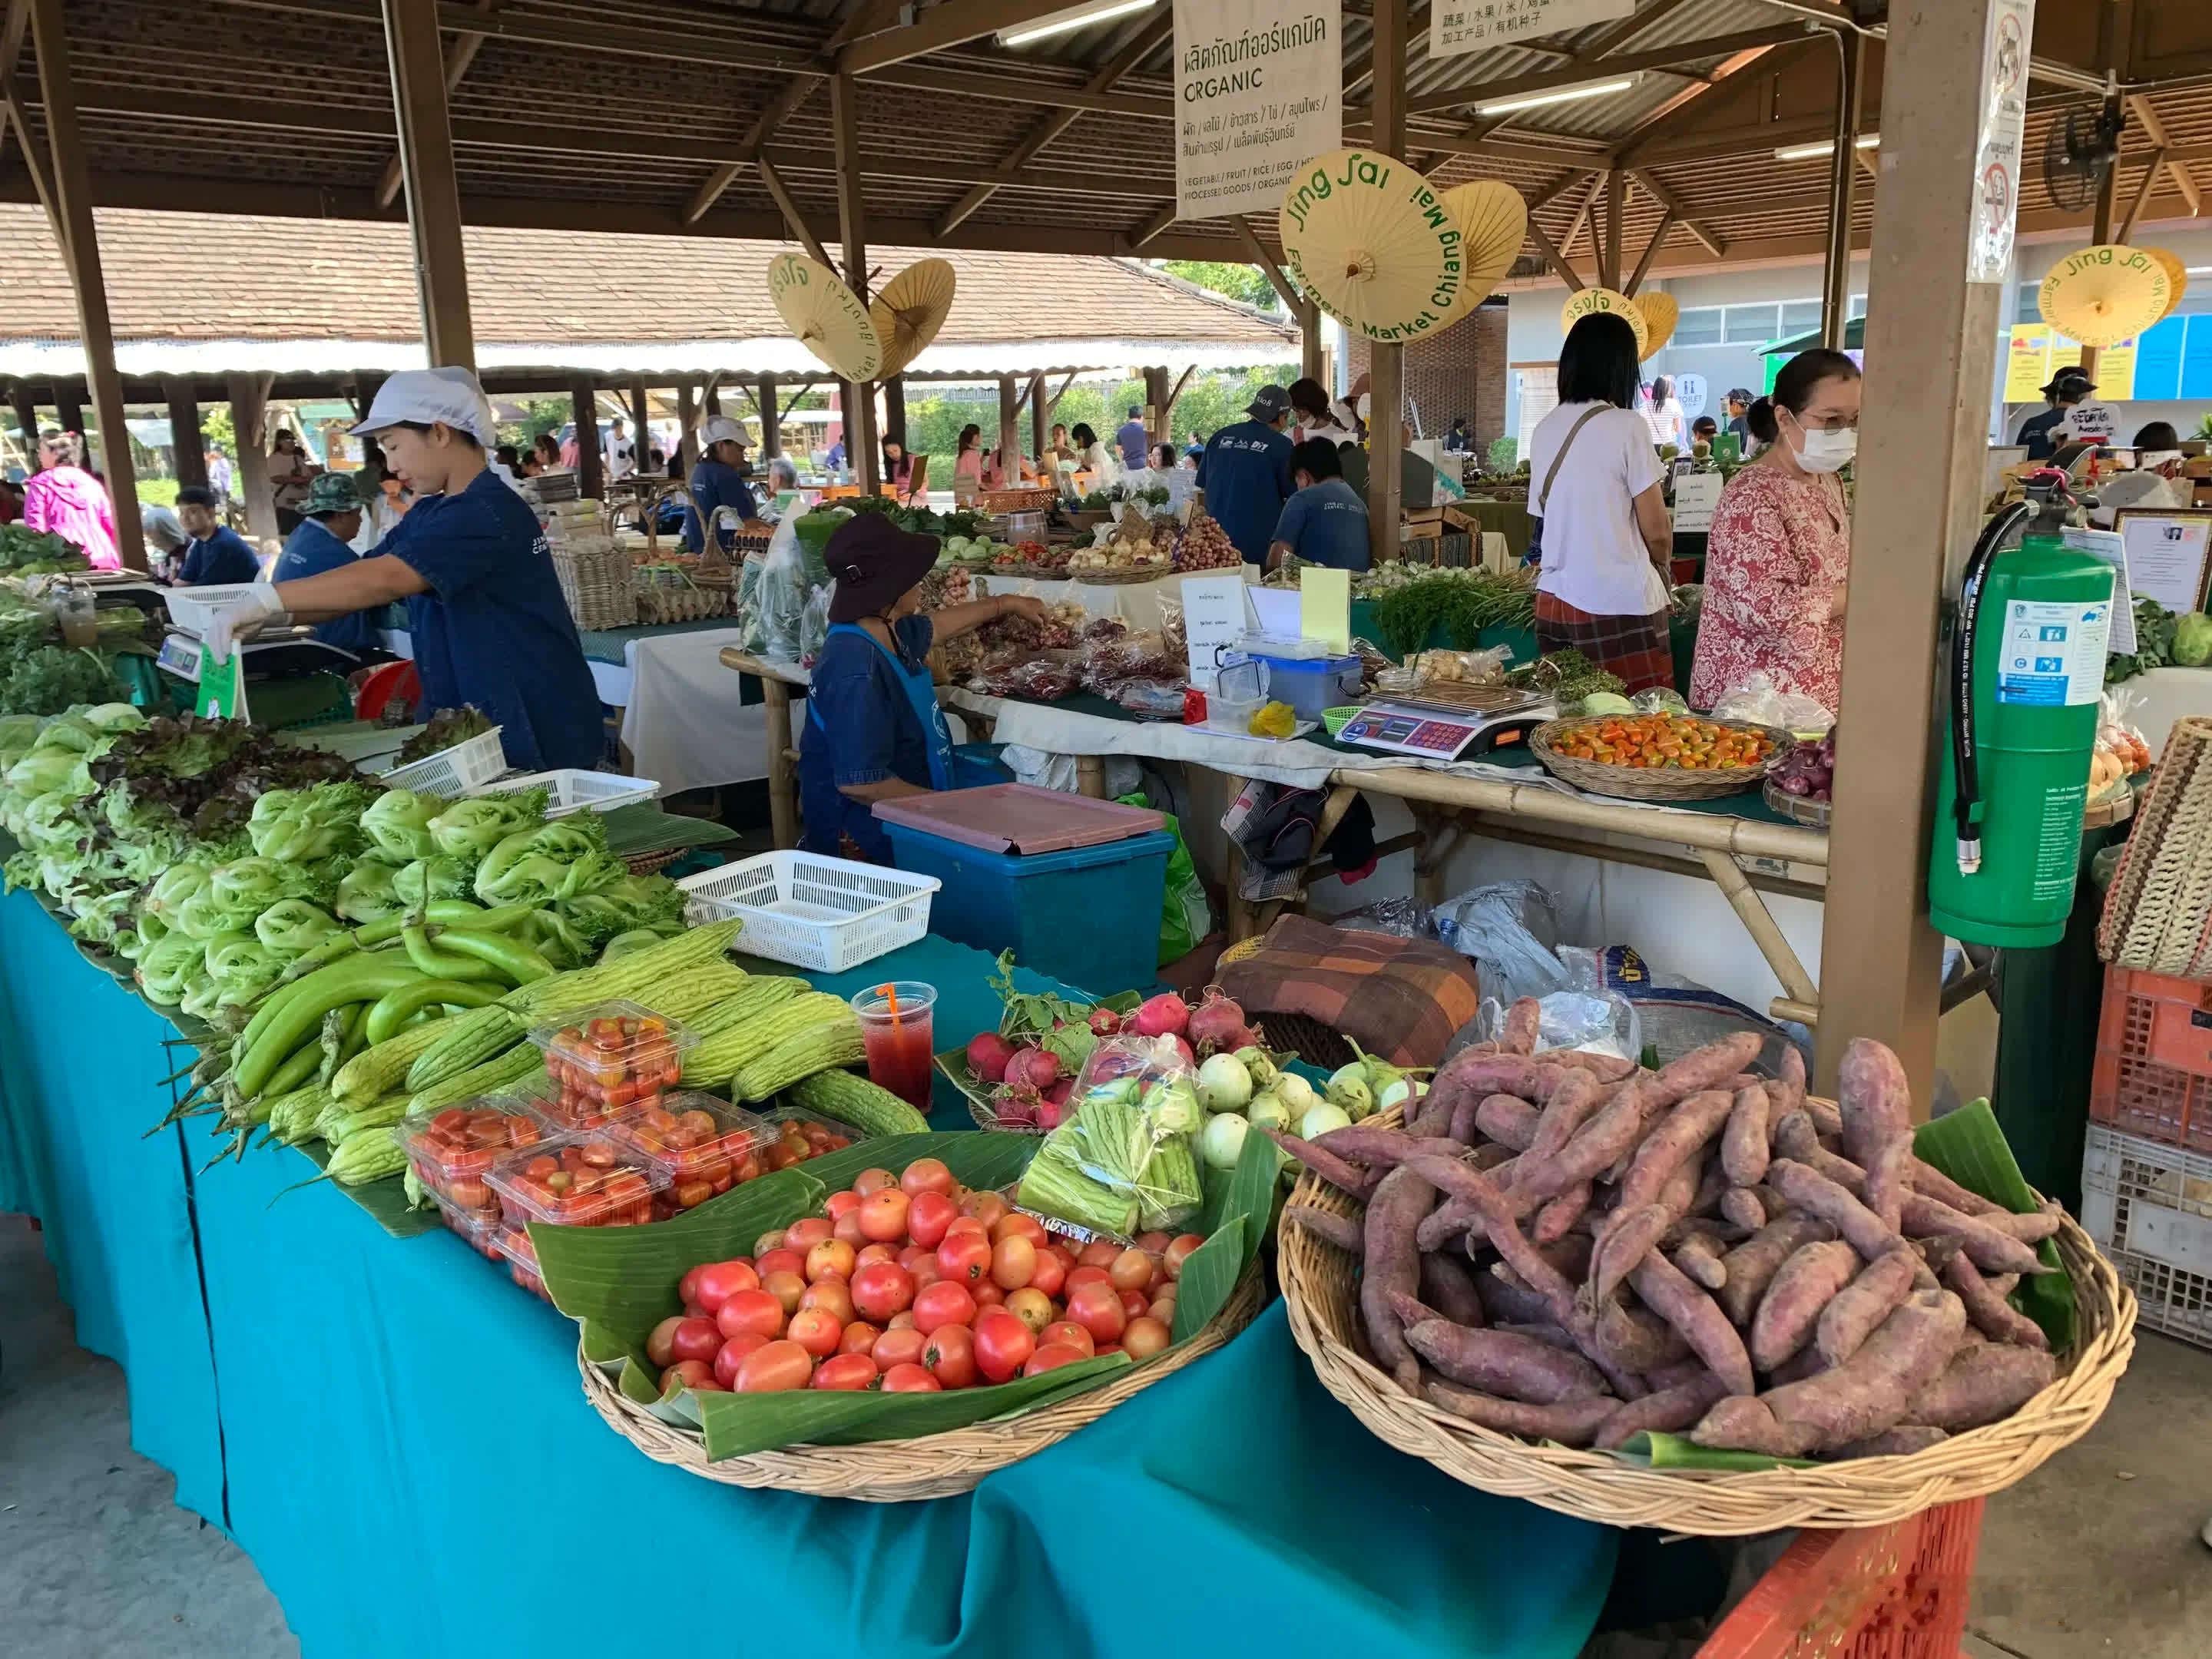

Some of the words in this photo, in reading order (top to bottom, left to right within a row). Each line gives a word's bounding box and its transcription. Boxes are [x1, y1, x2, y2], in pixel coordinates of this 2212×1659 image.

[1442, 25, 1484, 45] 加工产品
[1495, 12, 1541, 34] 有机种子
[1475, 5, 1494, 22] 水果
[1184, 67, 1263, 102] ORGANIC
[1227, 169, 1247, 180] FRUIT
[1253, 165, 1270, 176] RICE
[1277, 161, 1293, 172] EGG
[1223, 183, 1251, 195] GOODS
[1286, 167, 1333, 233] Jing
[1337, 154, 1390, 190] Jai
[1409, 185, 1449, 230] Mai
[1431, 230, 1462, 308] Chiang
[2065, 248, 2113, 276] Jing
[2119, 251, 2154, 274] Jai
[1286, 247, 1353, 328] Farmers
[1362, 311, 1440, 339] Market
